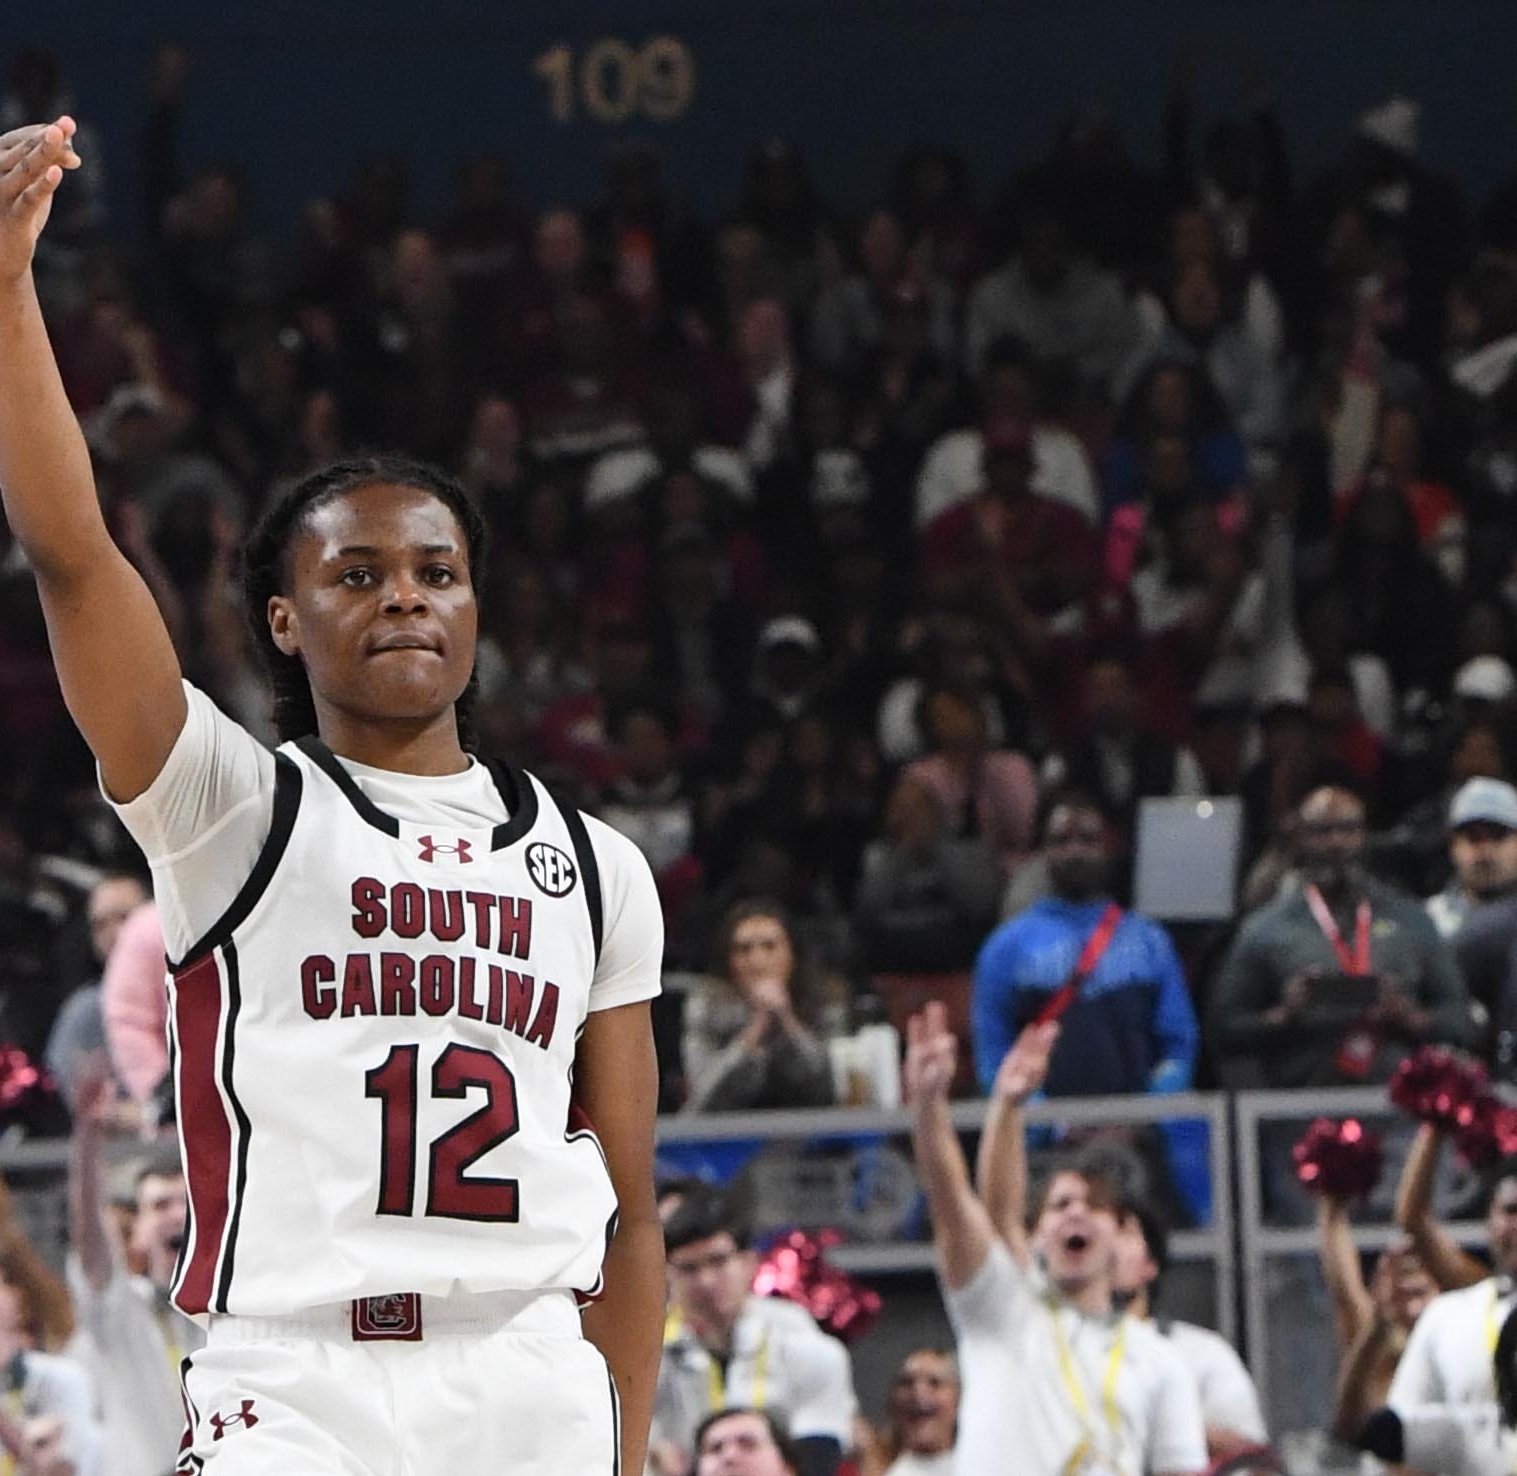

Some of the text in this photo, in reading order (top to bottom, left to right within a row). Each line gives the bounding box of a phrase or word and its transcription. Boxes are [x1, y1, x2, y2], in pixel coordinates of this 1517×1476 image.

[535, 36, 693, 121] 109
[527, 844, 574, 895] SEC
[351, 876, 532, 960] SOUTH
[300, 952, 560, 1051] CAROLINA
[364, 1042, 519, 1223] 12
